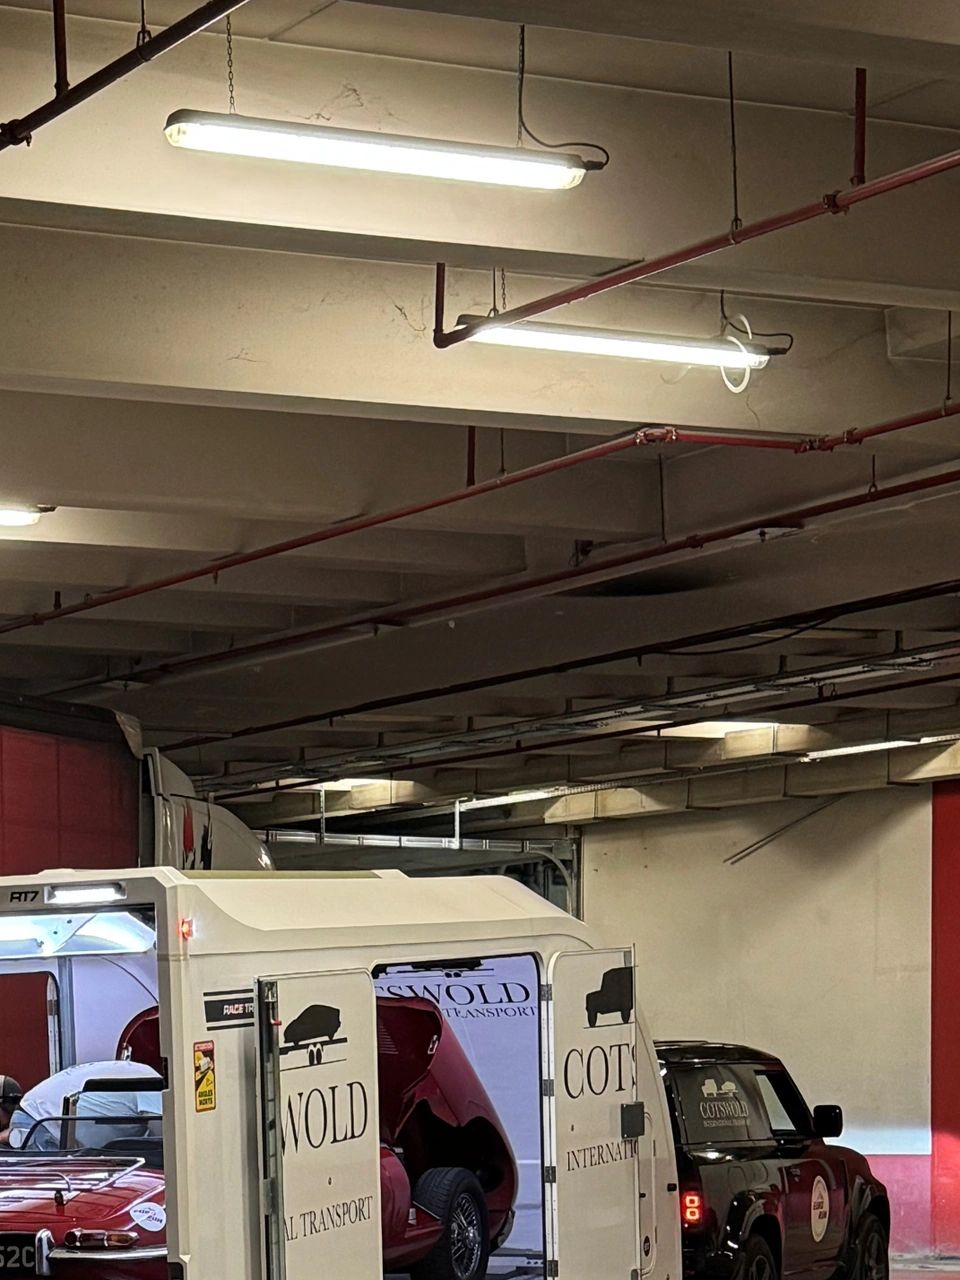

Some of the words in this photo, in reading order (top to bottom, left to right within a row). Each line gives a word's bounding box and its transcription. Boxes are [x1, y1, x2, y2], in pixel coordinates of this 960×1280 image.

[10, 891, 39, 902] RT7
[375, 982, 531, 1006] SWOLD
[442, 1006, 537, 1019] TRANSPORT
[563, 1043, 637, 1100] COT
[700, 1100, 749, 1119] COTSWOLD
[300, 1195, 373, 1237] TRANSPORT
